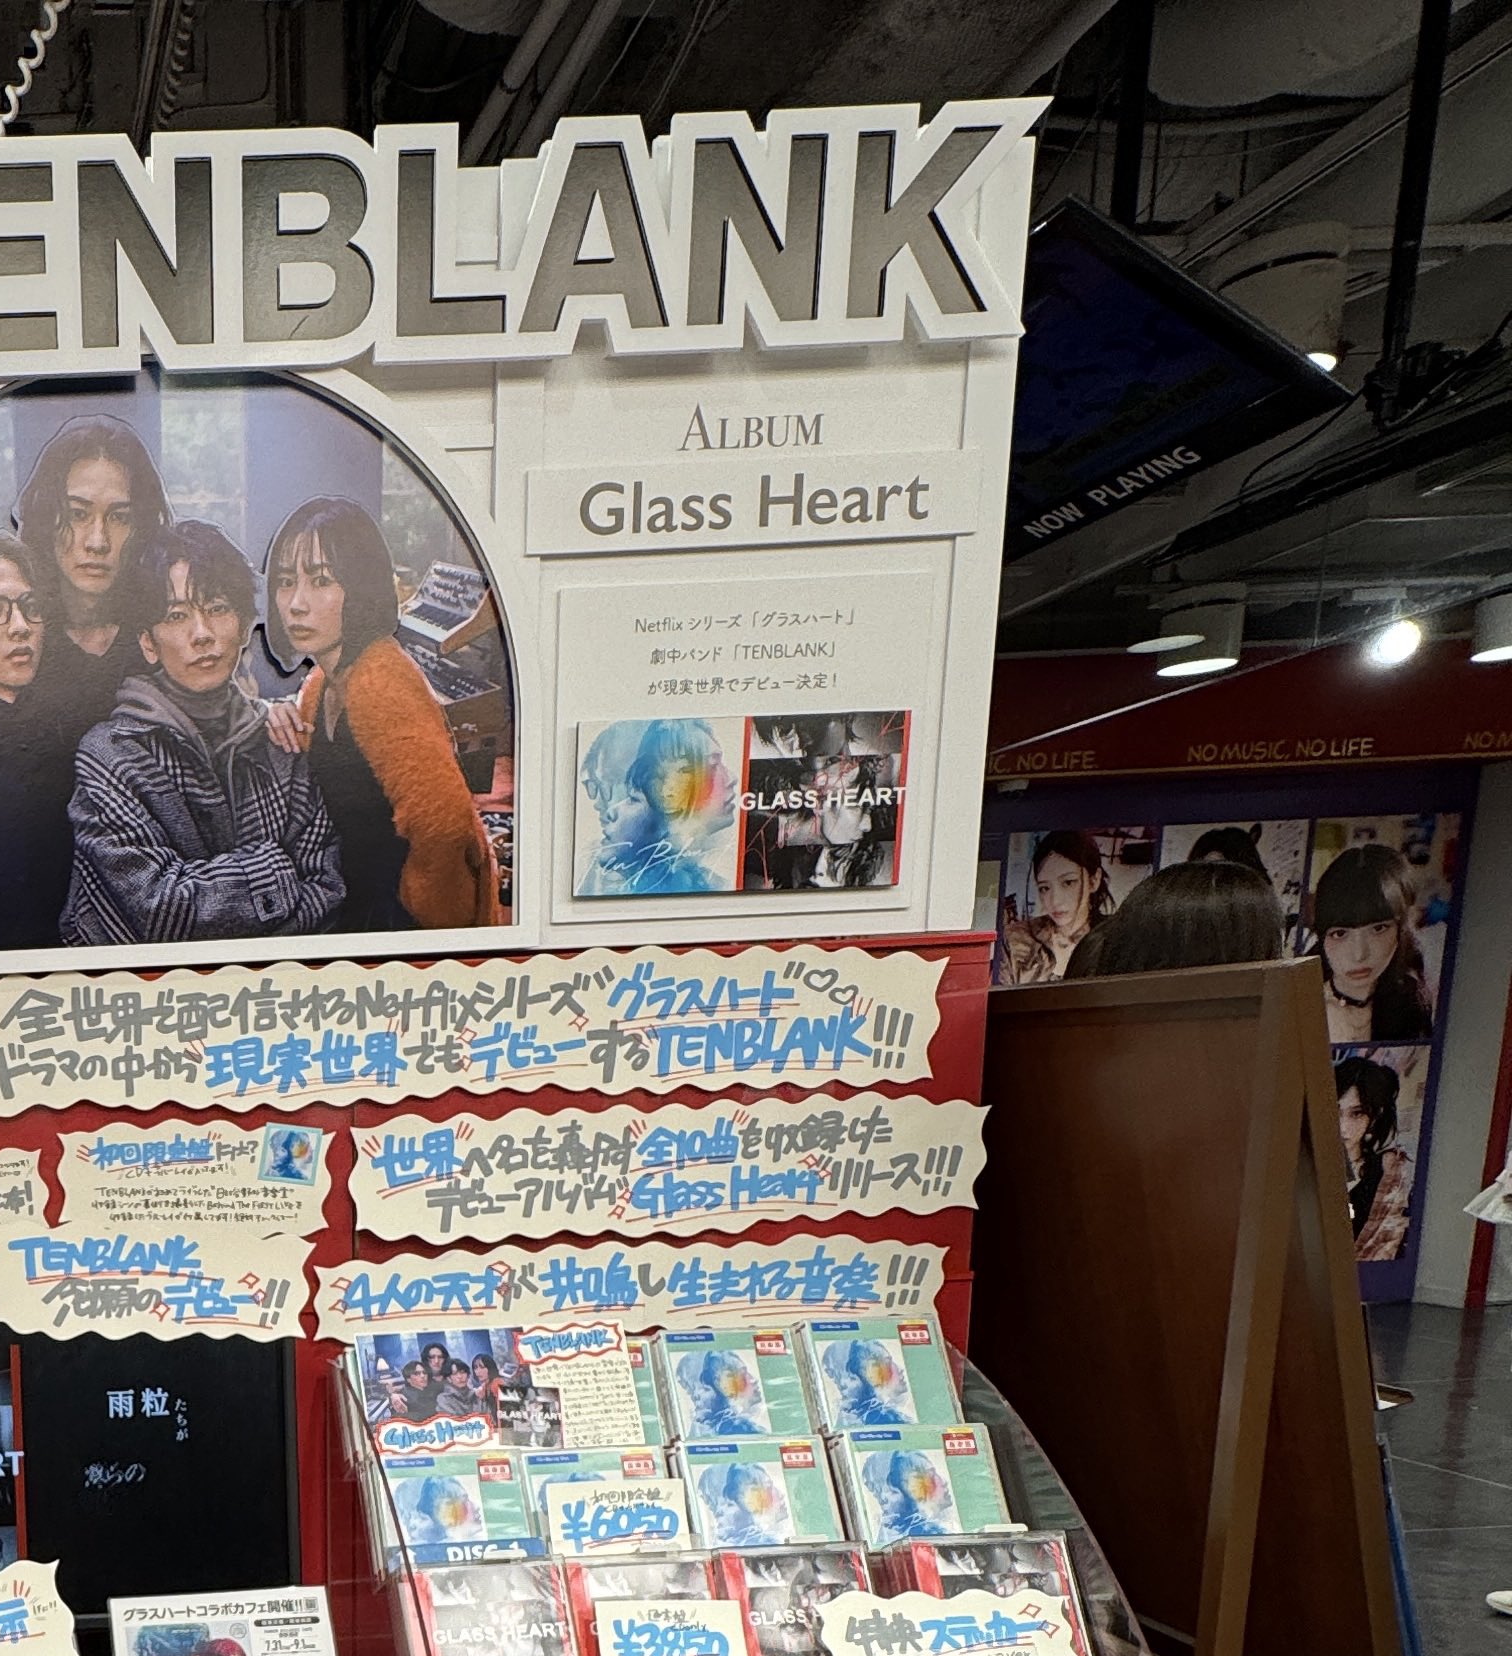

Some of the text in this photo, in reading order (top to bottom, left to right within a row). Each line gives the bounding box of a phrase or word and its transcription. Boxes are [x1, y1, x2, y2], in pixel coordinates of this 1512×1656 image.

[578, 472, 931, 535] Glass Heart
[1022, 446, 1202, 538] NOW PLAYING
[634, 609, 856, 633] Netflix シリーズ「グラスハート」
[650, 642, 836, 666] 劇中バンド「TENBLANK」
[1188, 745, 1218, 763] NO
[1296, 738, 1326, 759] NO
[1465, 731, 1496, 750] NO
[1017, 753, 1048, 771] NO
[740, 786, 906, 811] GLASS HEART
[8, 1233, 201, 1286] TENBLANK
[106, 1387, 170, 1418] 雨粒
[174, 1398, 189, 1442] たちが
[531, 1410, 562, 1421] HEART
[561, 1499, 680, 1554] ¥6050
[123, 1599, 303, 1621] グラスハートコラボカフェ開催!!
[749, 1608, 807, 1627] GLASS
[433, 1626, 497, 1646] GLASS
[502, 1620, 566, 1641] HEART
